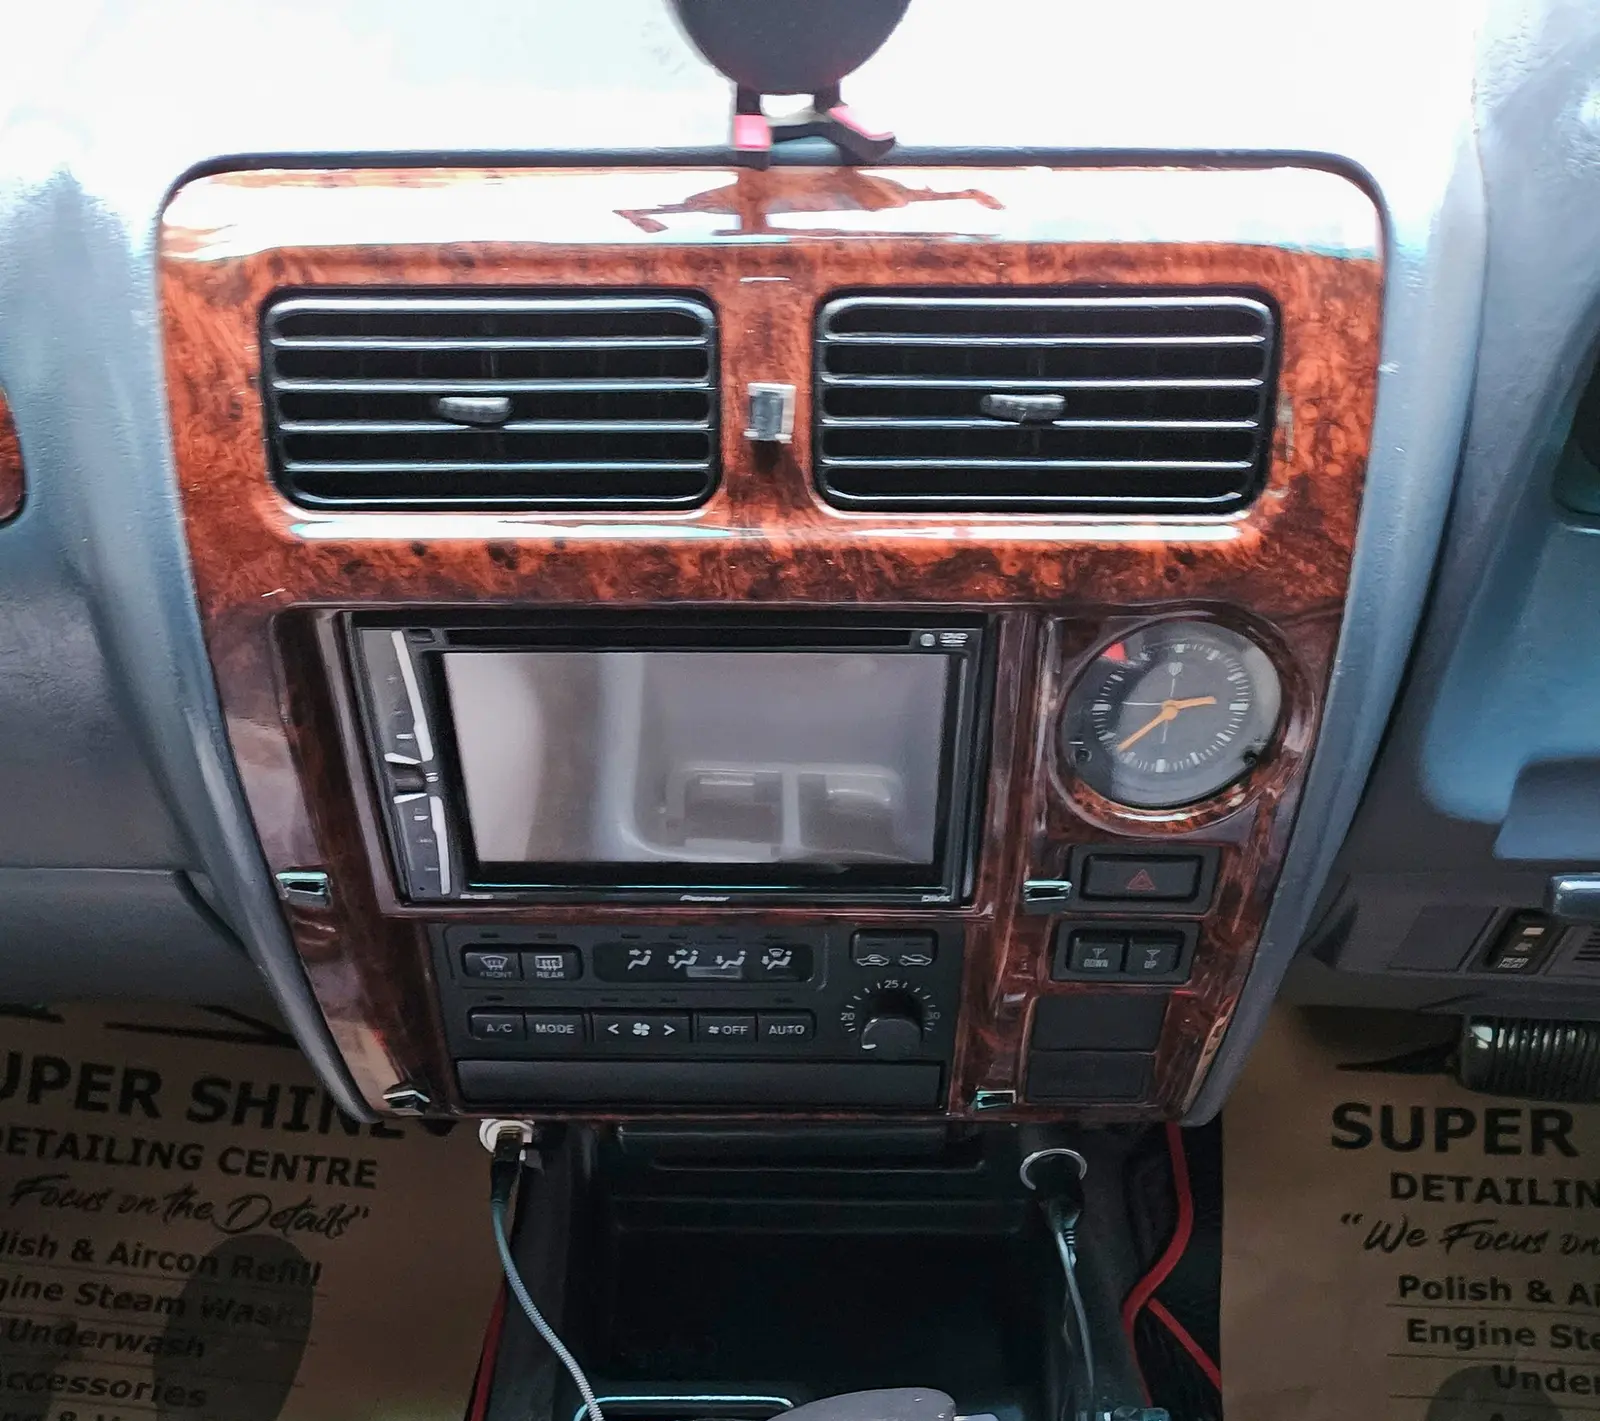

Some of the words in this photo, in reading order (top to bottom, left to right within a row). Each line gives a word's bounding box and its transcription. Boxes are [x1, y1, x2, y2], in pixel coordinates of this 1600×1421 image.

[536, 971, 565, 979] REAR
[884, 980, 900, 989] 25
[486, 1022, 513, 1034] A/C
[535, 1023, 575, 1036] MODE
[721, 1024, 749, 1036] OFF
[768, 1023, 805, 1036] AUTO
[840, 1012, 856, 1021] 20
[927, 1011, 942, 1021] 30
[186, 1075, 405, 1140] SHIN
[1330, 1101, 1580, 1158] SUPER
[0, 1123, 205, 1170] ETAILING
[216, 1146, 378, 1191] CENTRE
[8, 1172, 115, 1212] Focus
[117, 1193, 163, 1215] on
[161, 1180, 216, 1225] the
[1440, 1217, 1551, 1256] Focus
[70, 1237, 94, 1263] &
[106, 1240, 219, 1278] Aircon
[230, 1254, 322, 1285] Refill
[75, 1281, 186, 1316] Steam
[1398, 1273, 1511, 1301] Polish
[1526, 1279, 1555, 1303] &
[8, 1317, 206, 1358] Underwash
[1406, 1318, 1536, 1351] Engine
